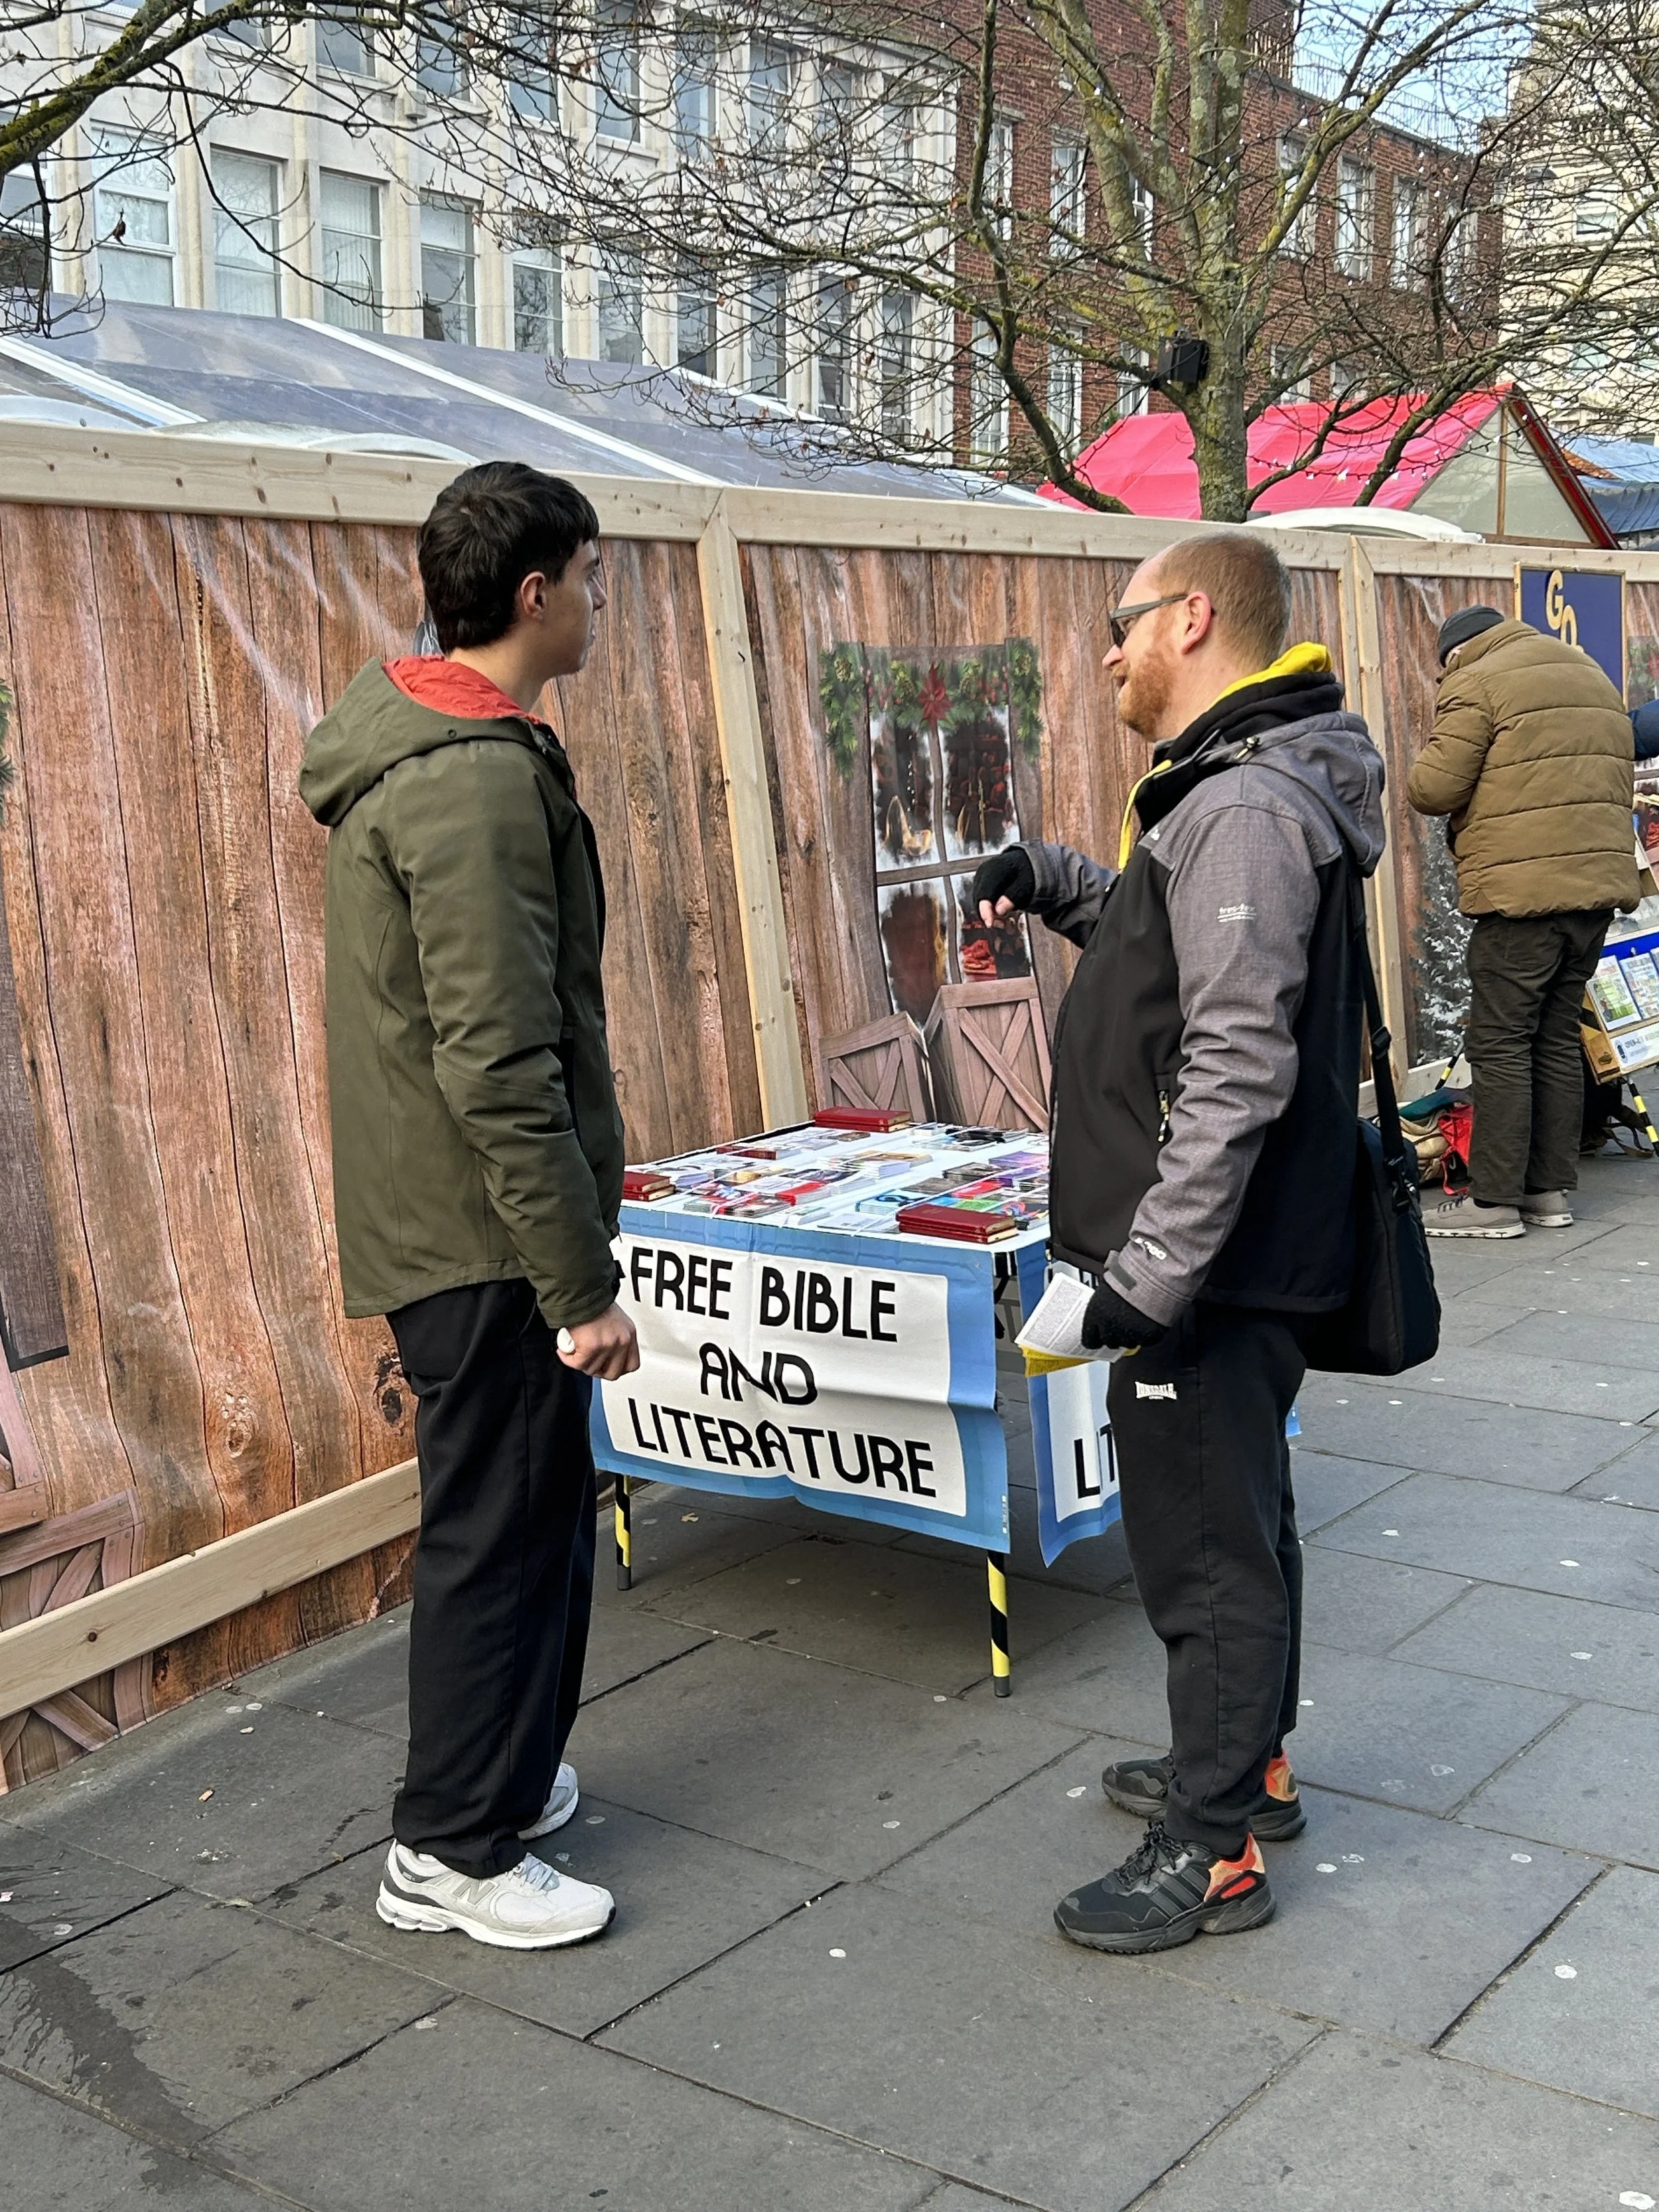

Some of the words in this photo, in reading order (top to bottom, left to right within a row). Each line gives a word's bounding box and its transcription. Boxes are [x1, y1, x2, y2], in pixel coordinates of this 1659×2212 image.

[631, 1246, 733, 1320] FREE
[760, 1266, 897, 1343] BIBLE
[699, 1343, 818, 1405] AND
[628, 1398, 936, 1497] LITERATURE
